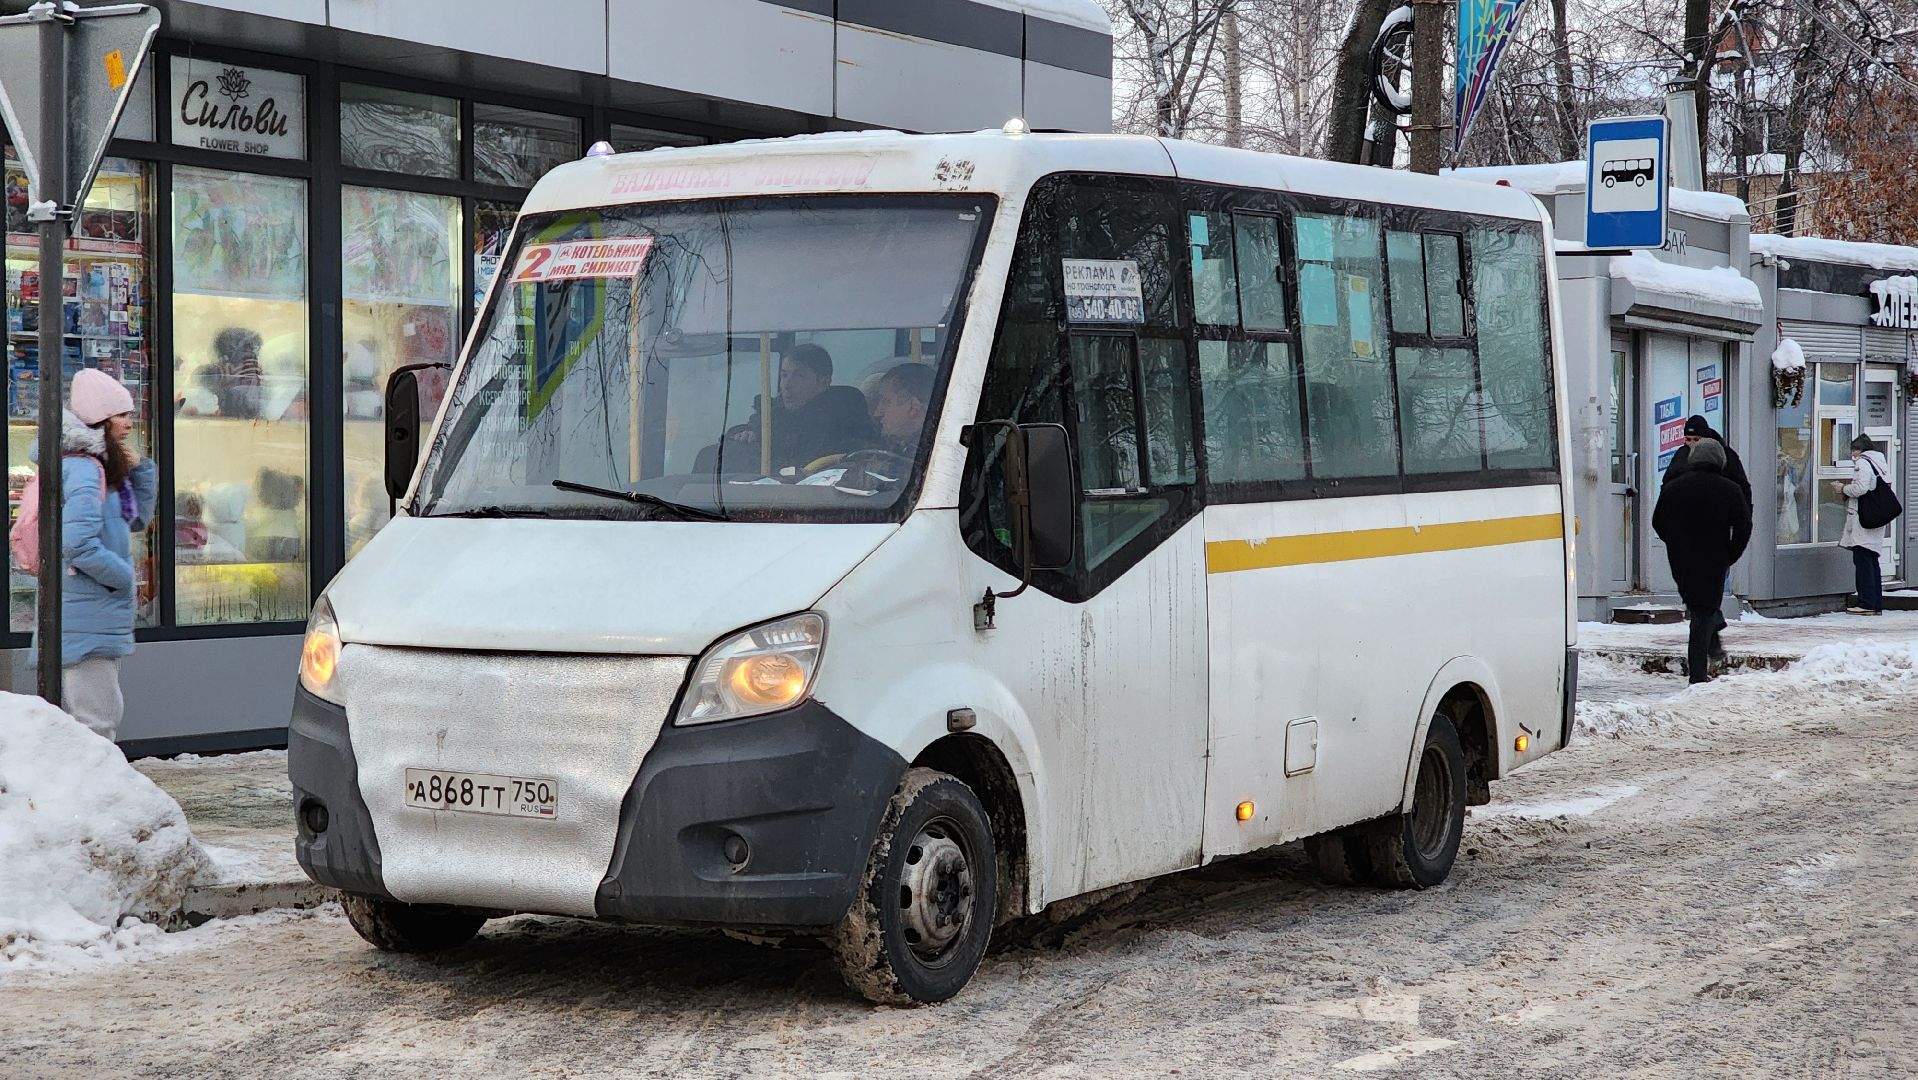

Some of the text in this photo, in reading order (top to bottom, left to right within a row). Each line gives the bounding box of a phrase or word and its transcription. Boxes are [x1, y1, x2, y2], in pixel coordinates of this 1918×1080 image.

[181, 80, 288, 137] Сильви
[200, 137, 269, 154] FLOWER SHOP
[571, 243, 648, 259] КОТЕЛЬНИКИ
[517, 247, 552, 279] 2
[580, 260, 640, 274] СИЛИКАТ
[1065, 265, 1116, 281] РЕКЛАМА
[1660, 401, 1676, 420] ТАБАК
[413, 775, 550, 809] А868ТТ 750
[520, 803, 540, 813] RUS
